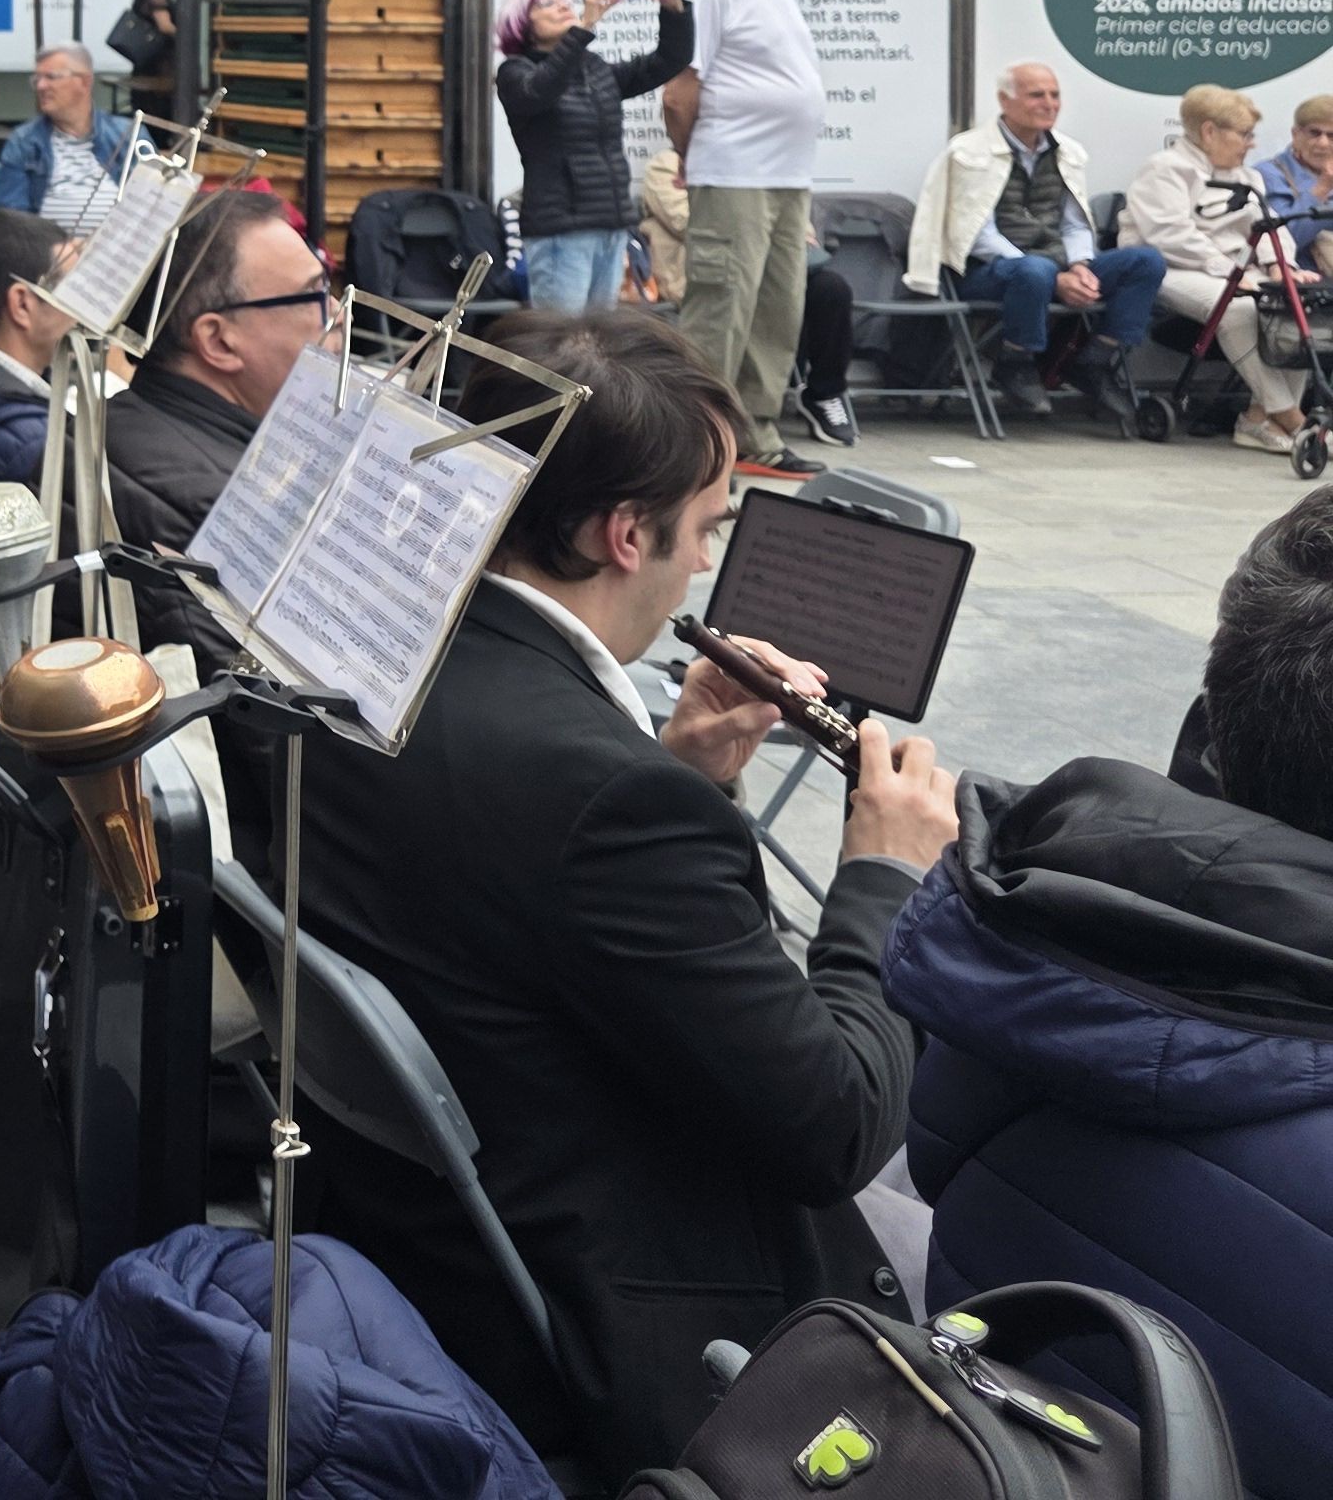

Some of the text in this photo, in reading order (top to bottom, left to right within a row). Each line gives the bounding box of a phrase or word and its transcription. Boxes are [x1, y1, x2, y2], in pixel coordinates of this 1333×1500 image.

[847, 10, 902, 24] terme
[1094, 15, 1331, 36] Primer cicle d'educació
[1094, 36, 1272, 60] infantil (0-3 anys)
[859, 87, 877, 103] el
